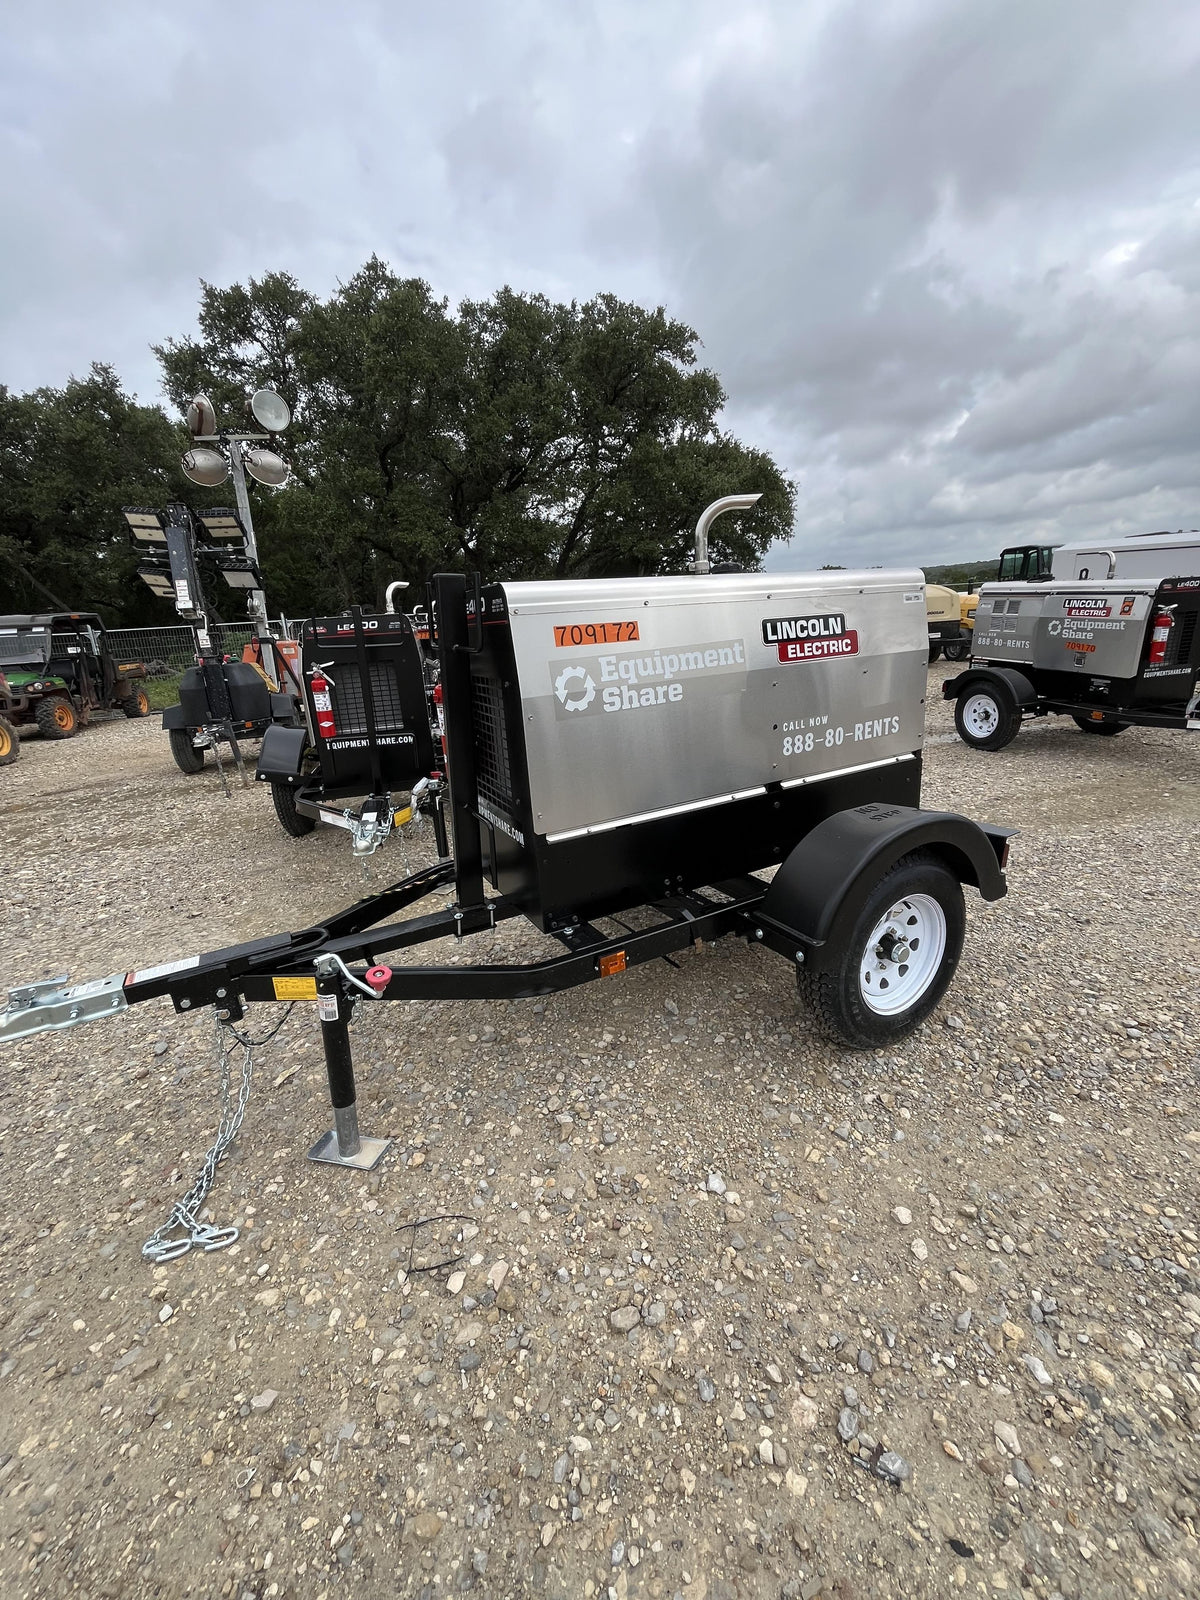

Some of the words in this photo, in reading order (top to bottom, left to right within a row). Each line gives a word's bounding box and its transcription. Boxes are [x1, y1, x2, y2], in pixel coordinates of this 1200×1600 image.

[1177, 580, 1200, 588] LE400
[1064, 600, 1106, 609] LINCOLN
[1071, 608, 1107, 617] ELECTRIC
[766, 617, 842, 641] LINCOLN
[1063, 618, 1126, 631] Equipment
[555, 621, 638, 646] 709172
[1062, 629, 1094, 640] Share
[787, 639, 852, 659] ELECTRIC
[977, 637, 1030, 649] 888-80-RENTS
[598, 642, 745, 684] Equipment
[602, 683, 684, 713] Share
[783, 720, 806, 732] CALL
[809, 715, 829, 727] NOW
[326, 735, 414, 750] EQUIPMENTHARE.COM
[782, 715, 901, 756] 888-80-RENTS
